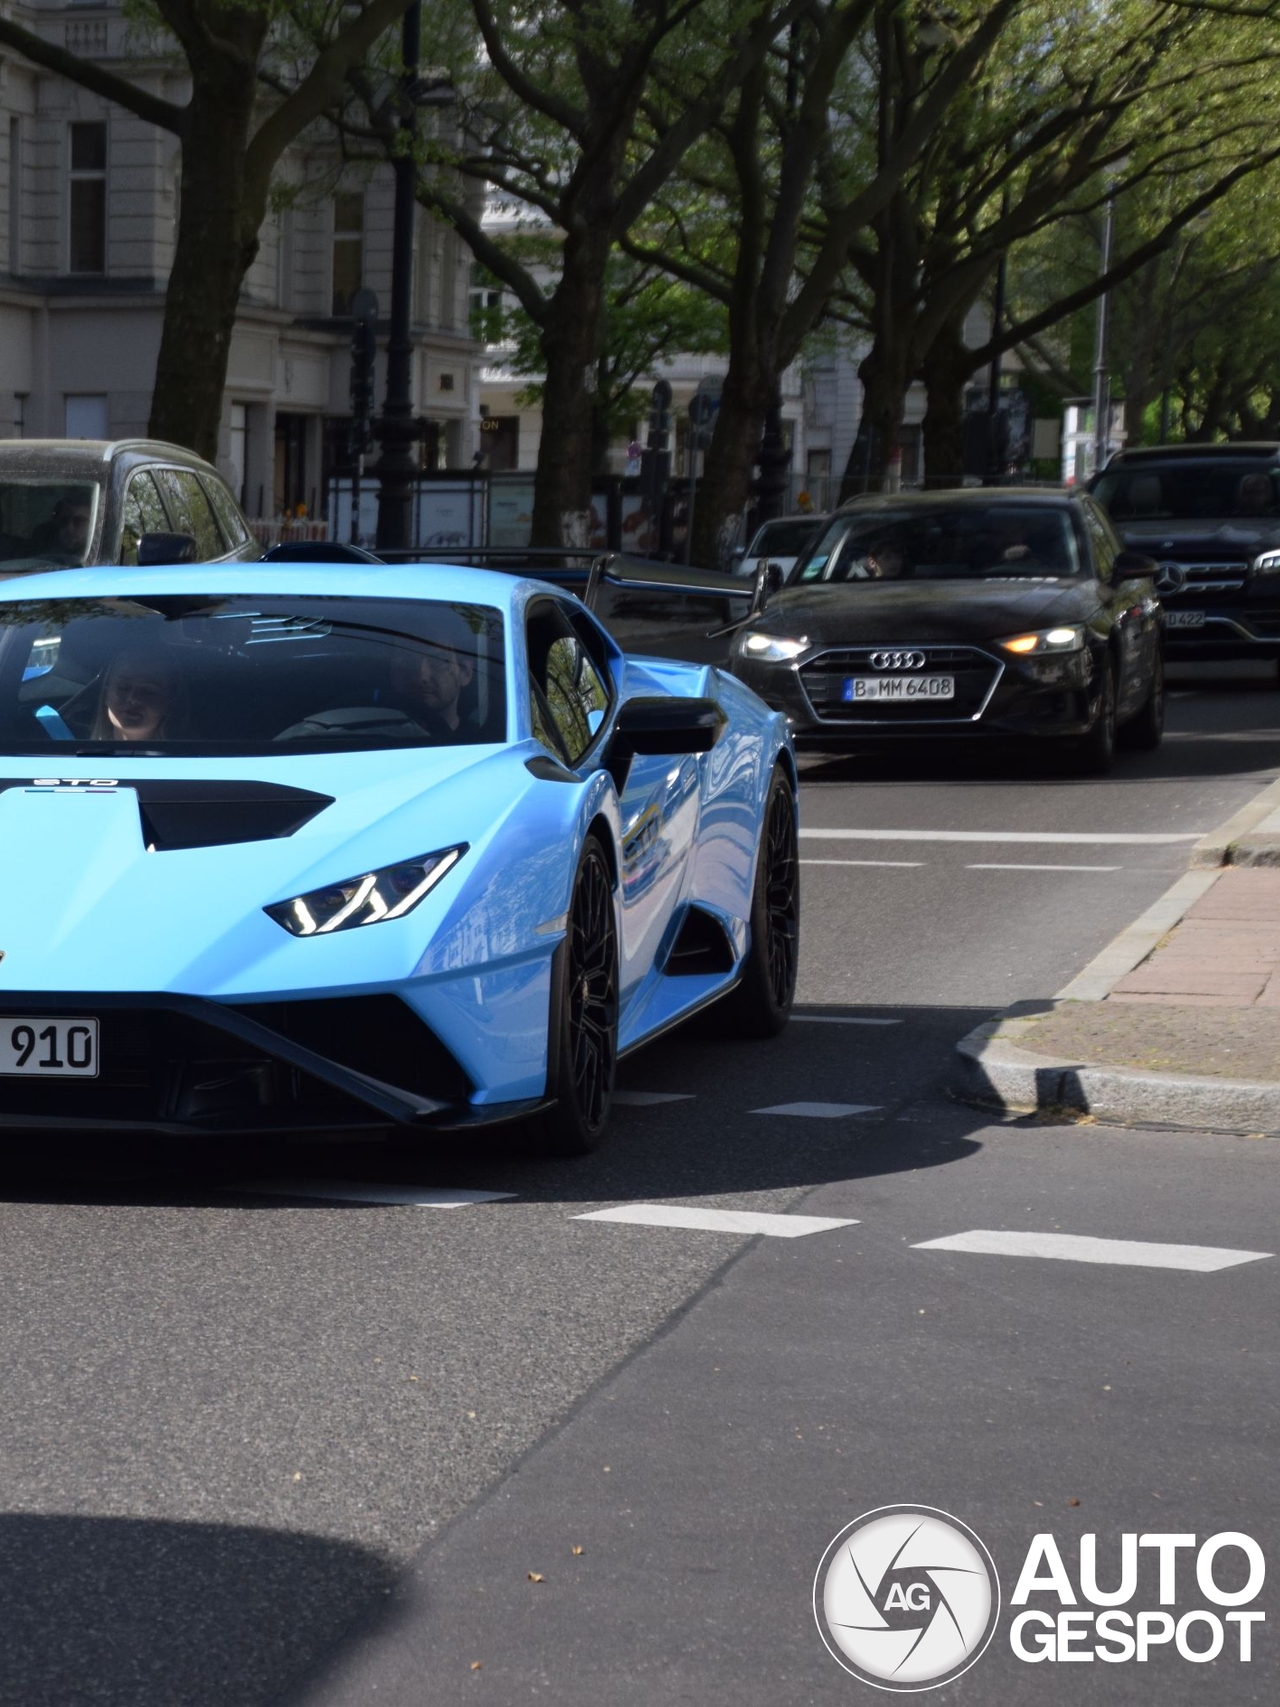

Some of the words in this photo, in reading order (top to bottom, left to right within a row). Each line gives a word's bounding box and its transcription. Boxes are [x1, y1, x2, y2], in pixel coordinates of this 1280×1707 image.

[855, 680, 867, 697] B
[878, 679, 903, 696] MM
[906, 678, 952, 696] 6408
[11, 1025, 92, 1068] 910
